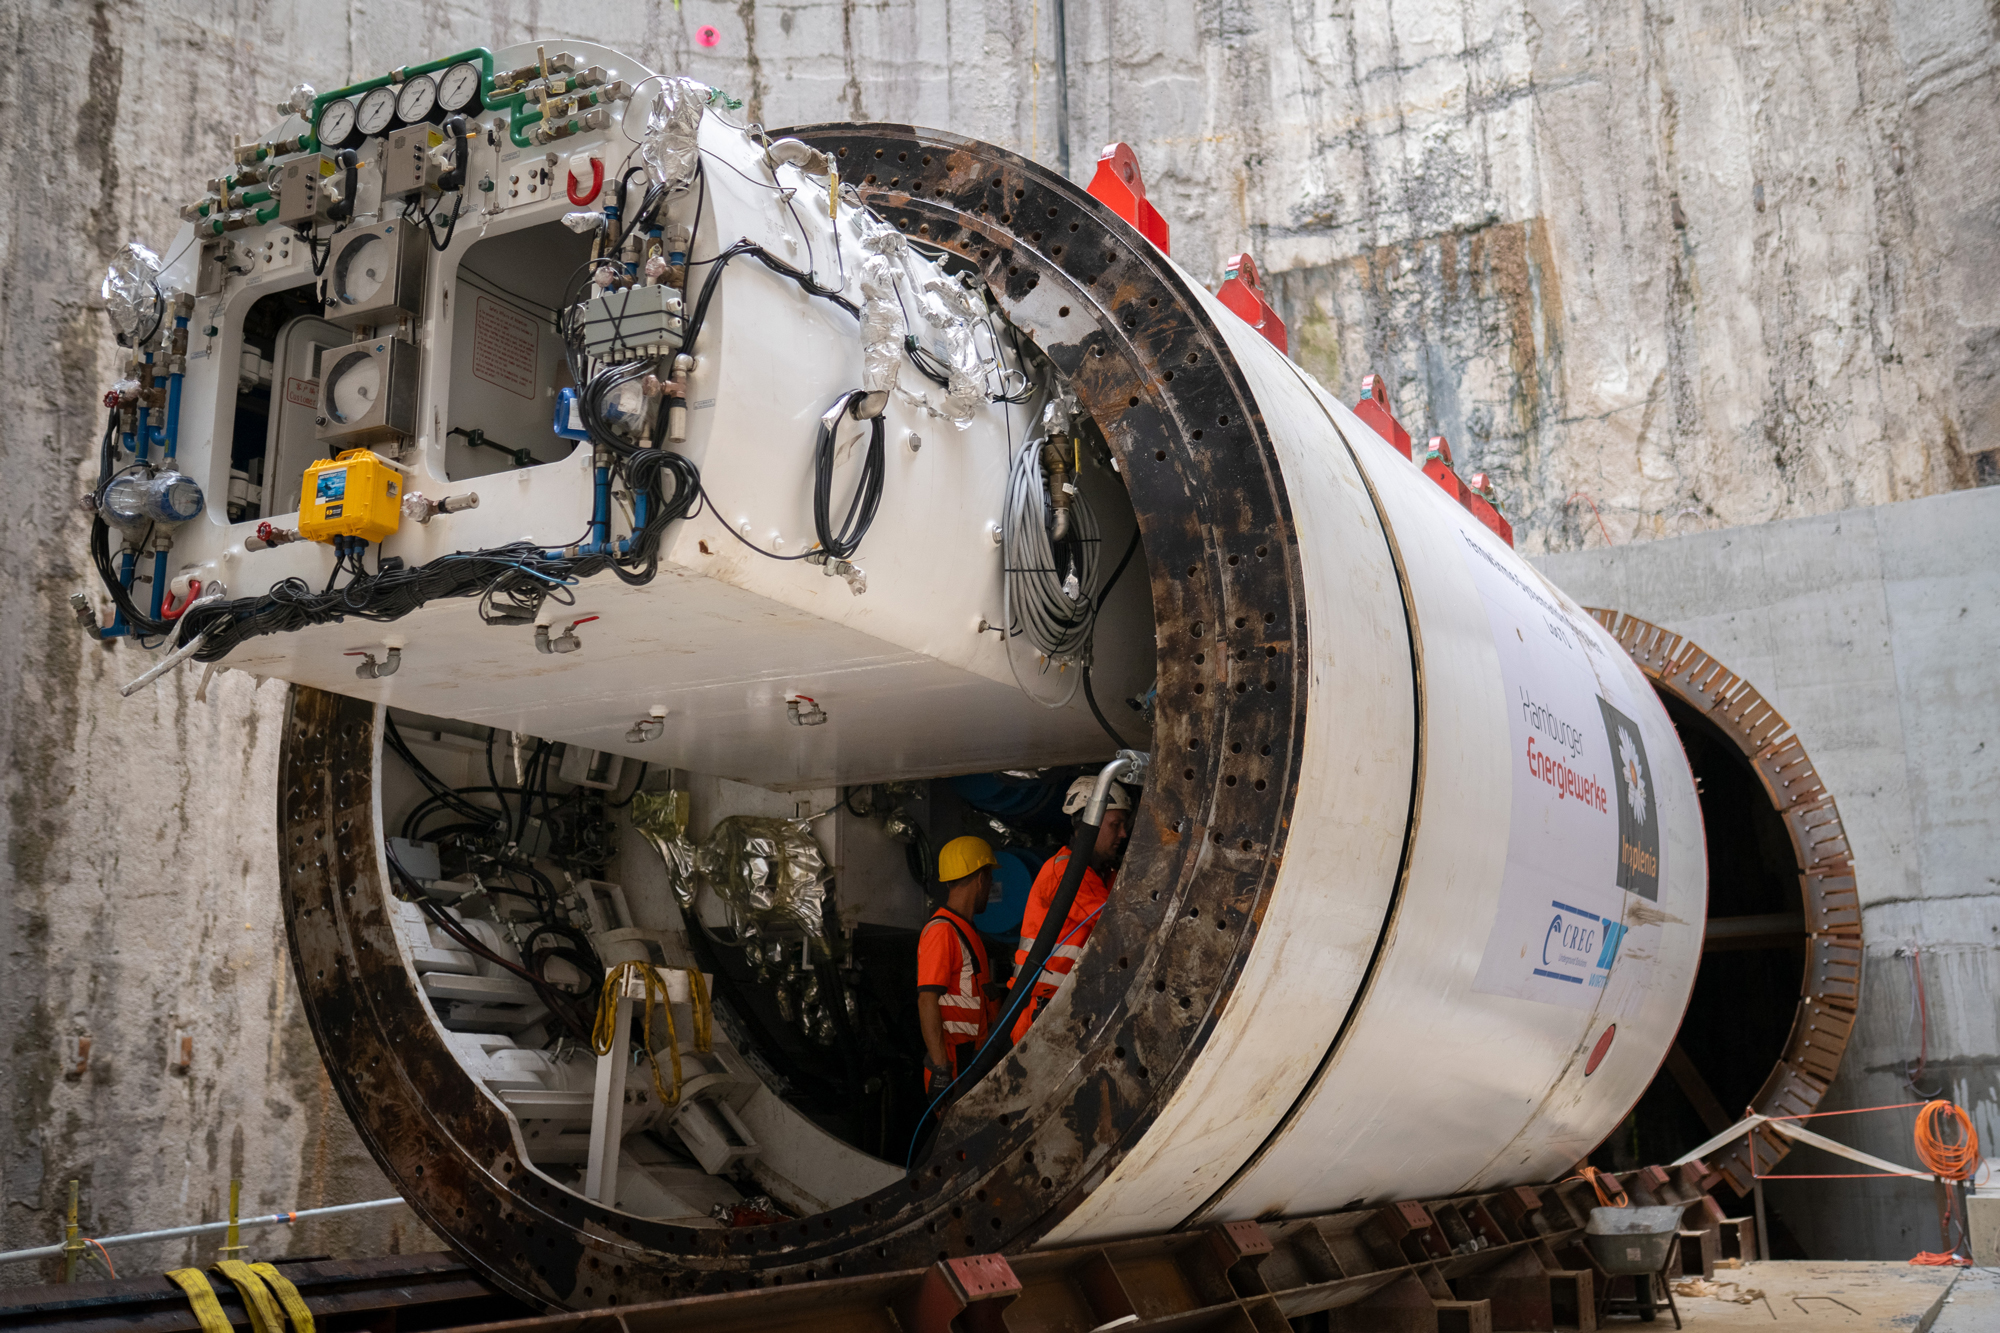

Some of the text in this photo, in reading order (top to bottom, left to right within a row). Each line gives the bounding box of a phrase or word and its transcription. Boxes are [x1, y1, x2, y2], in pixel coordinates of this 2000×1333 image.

[290, 391, 316, 406] Customer
[1519, 685, 1583, 758] Hamburger
[1527, 736, 1607, 814] Energiewerke
[1622, 834, 1656, 878] Implenia
[1563, 924, 1595, 954] CREG
